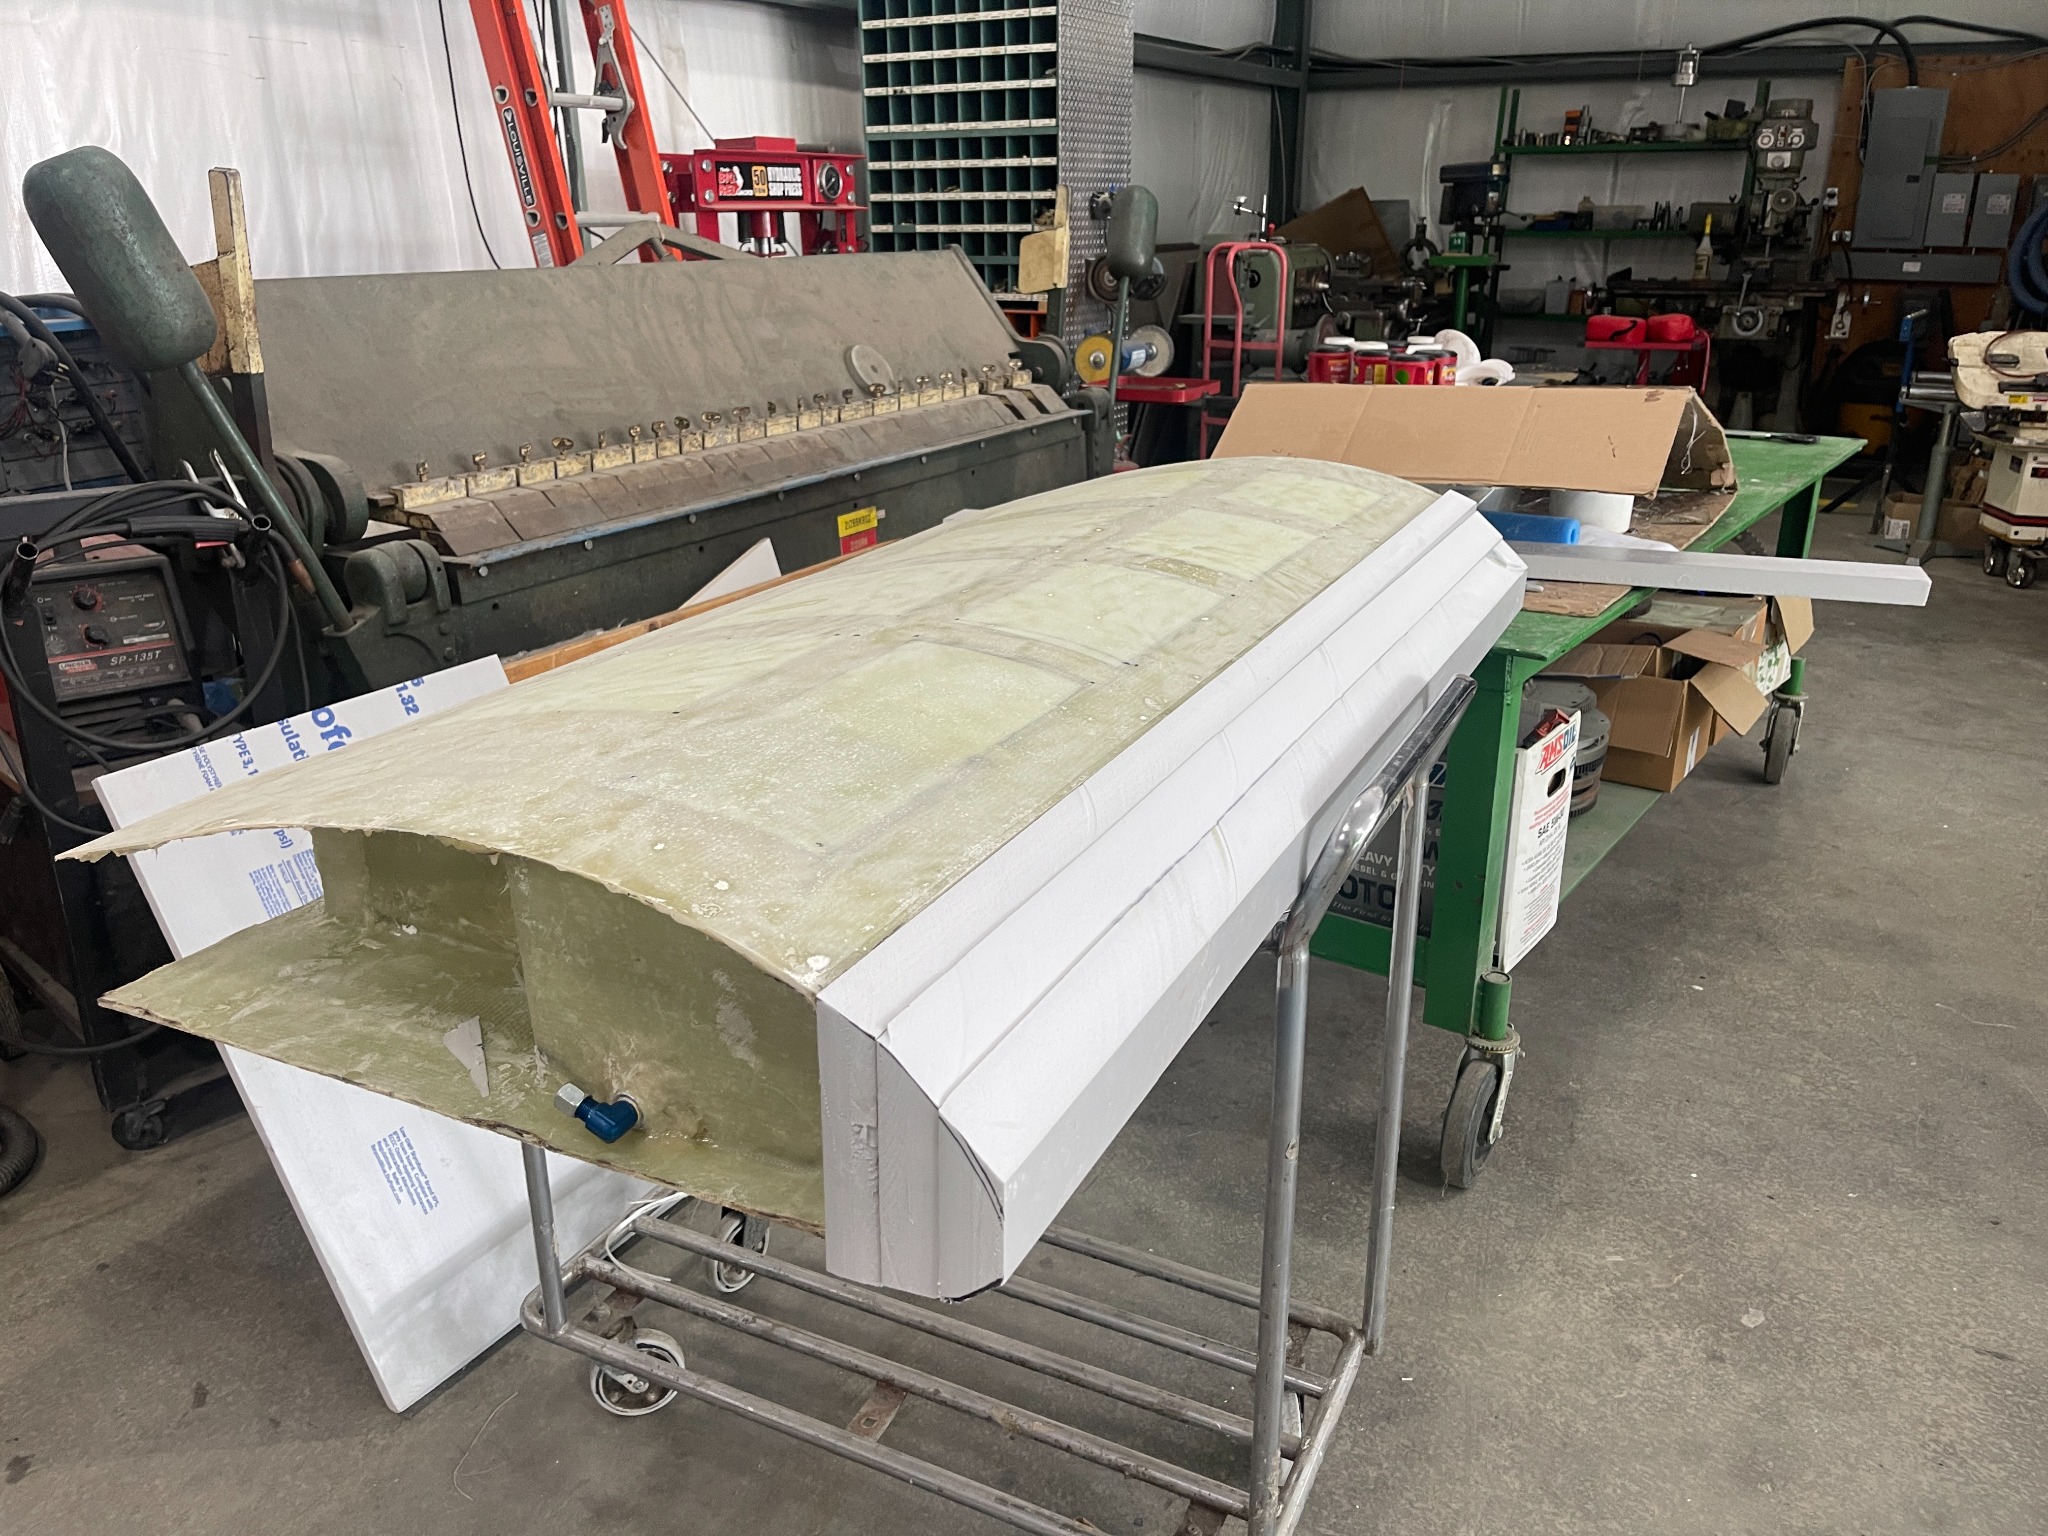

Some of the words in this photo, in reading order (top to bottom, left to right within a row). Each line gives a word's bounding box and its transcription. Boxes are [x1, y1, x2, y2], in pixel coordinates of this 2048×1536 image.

[508, 122, 534, 205] LOUISVILLE
[753, 169, 767, 185] 50
[1539, 723, 1578, 770] AMSOIL
[273, 829, 294, 849] psi)
